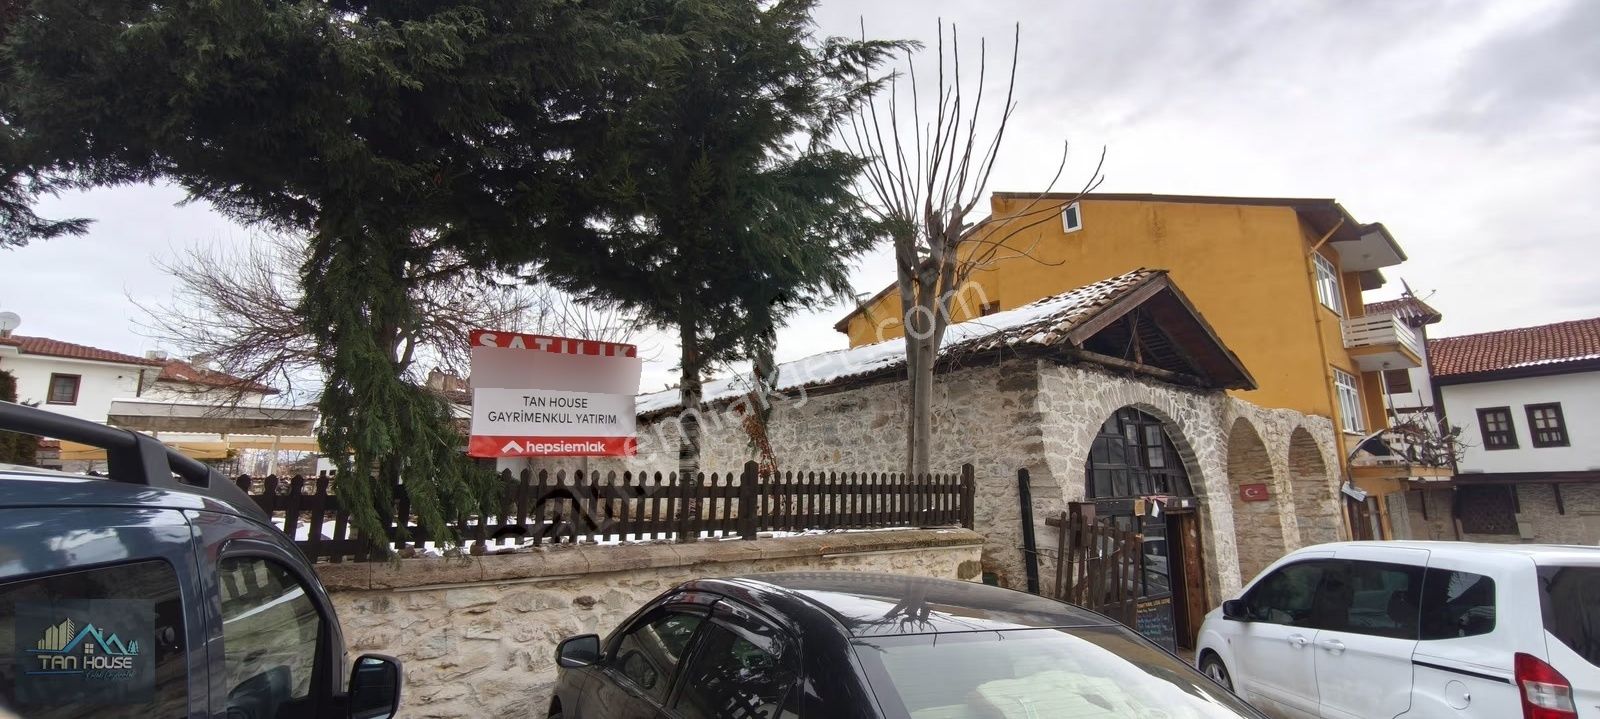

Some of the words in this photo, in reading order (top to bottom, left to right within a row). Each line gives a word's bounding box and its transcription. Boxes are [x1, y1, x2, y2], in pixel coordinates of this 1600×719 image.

[523, 396, 546, 407] TAN
[550, 397, 588, 408] HOUSE
[488, 410, 572, 424] GAYRİMENKUL
[576, 414, 617, 424] YATIRIM
[526, 440, 605, 454] hepsiemlak
